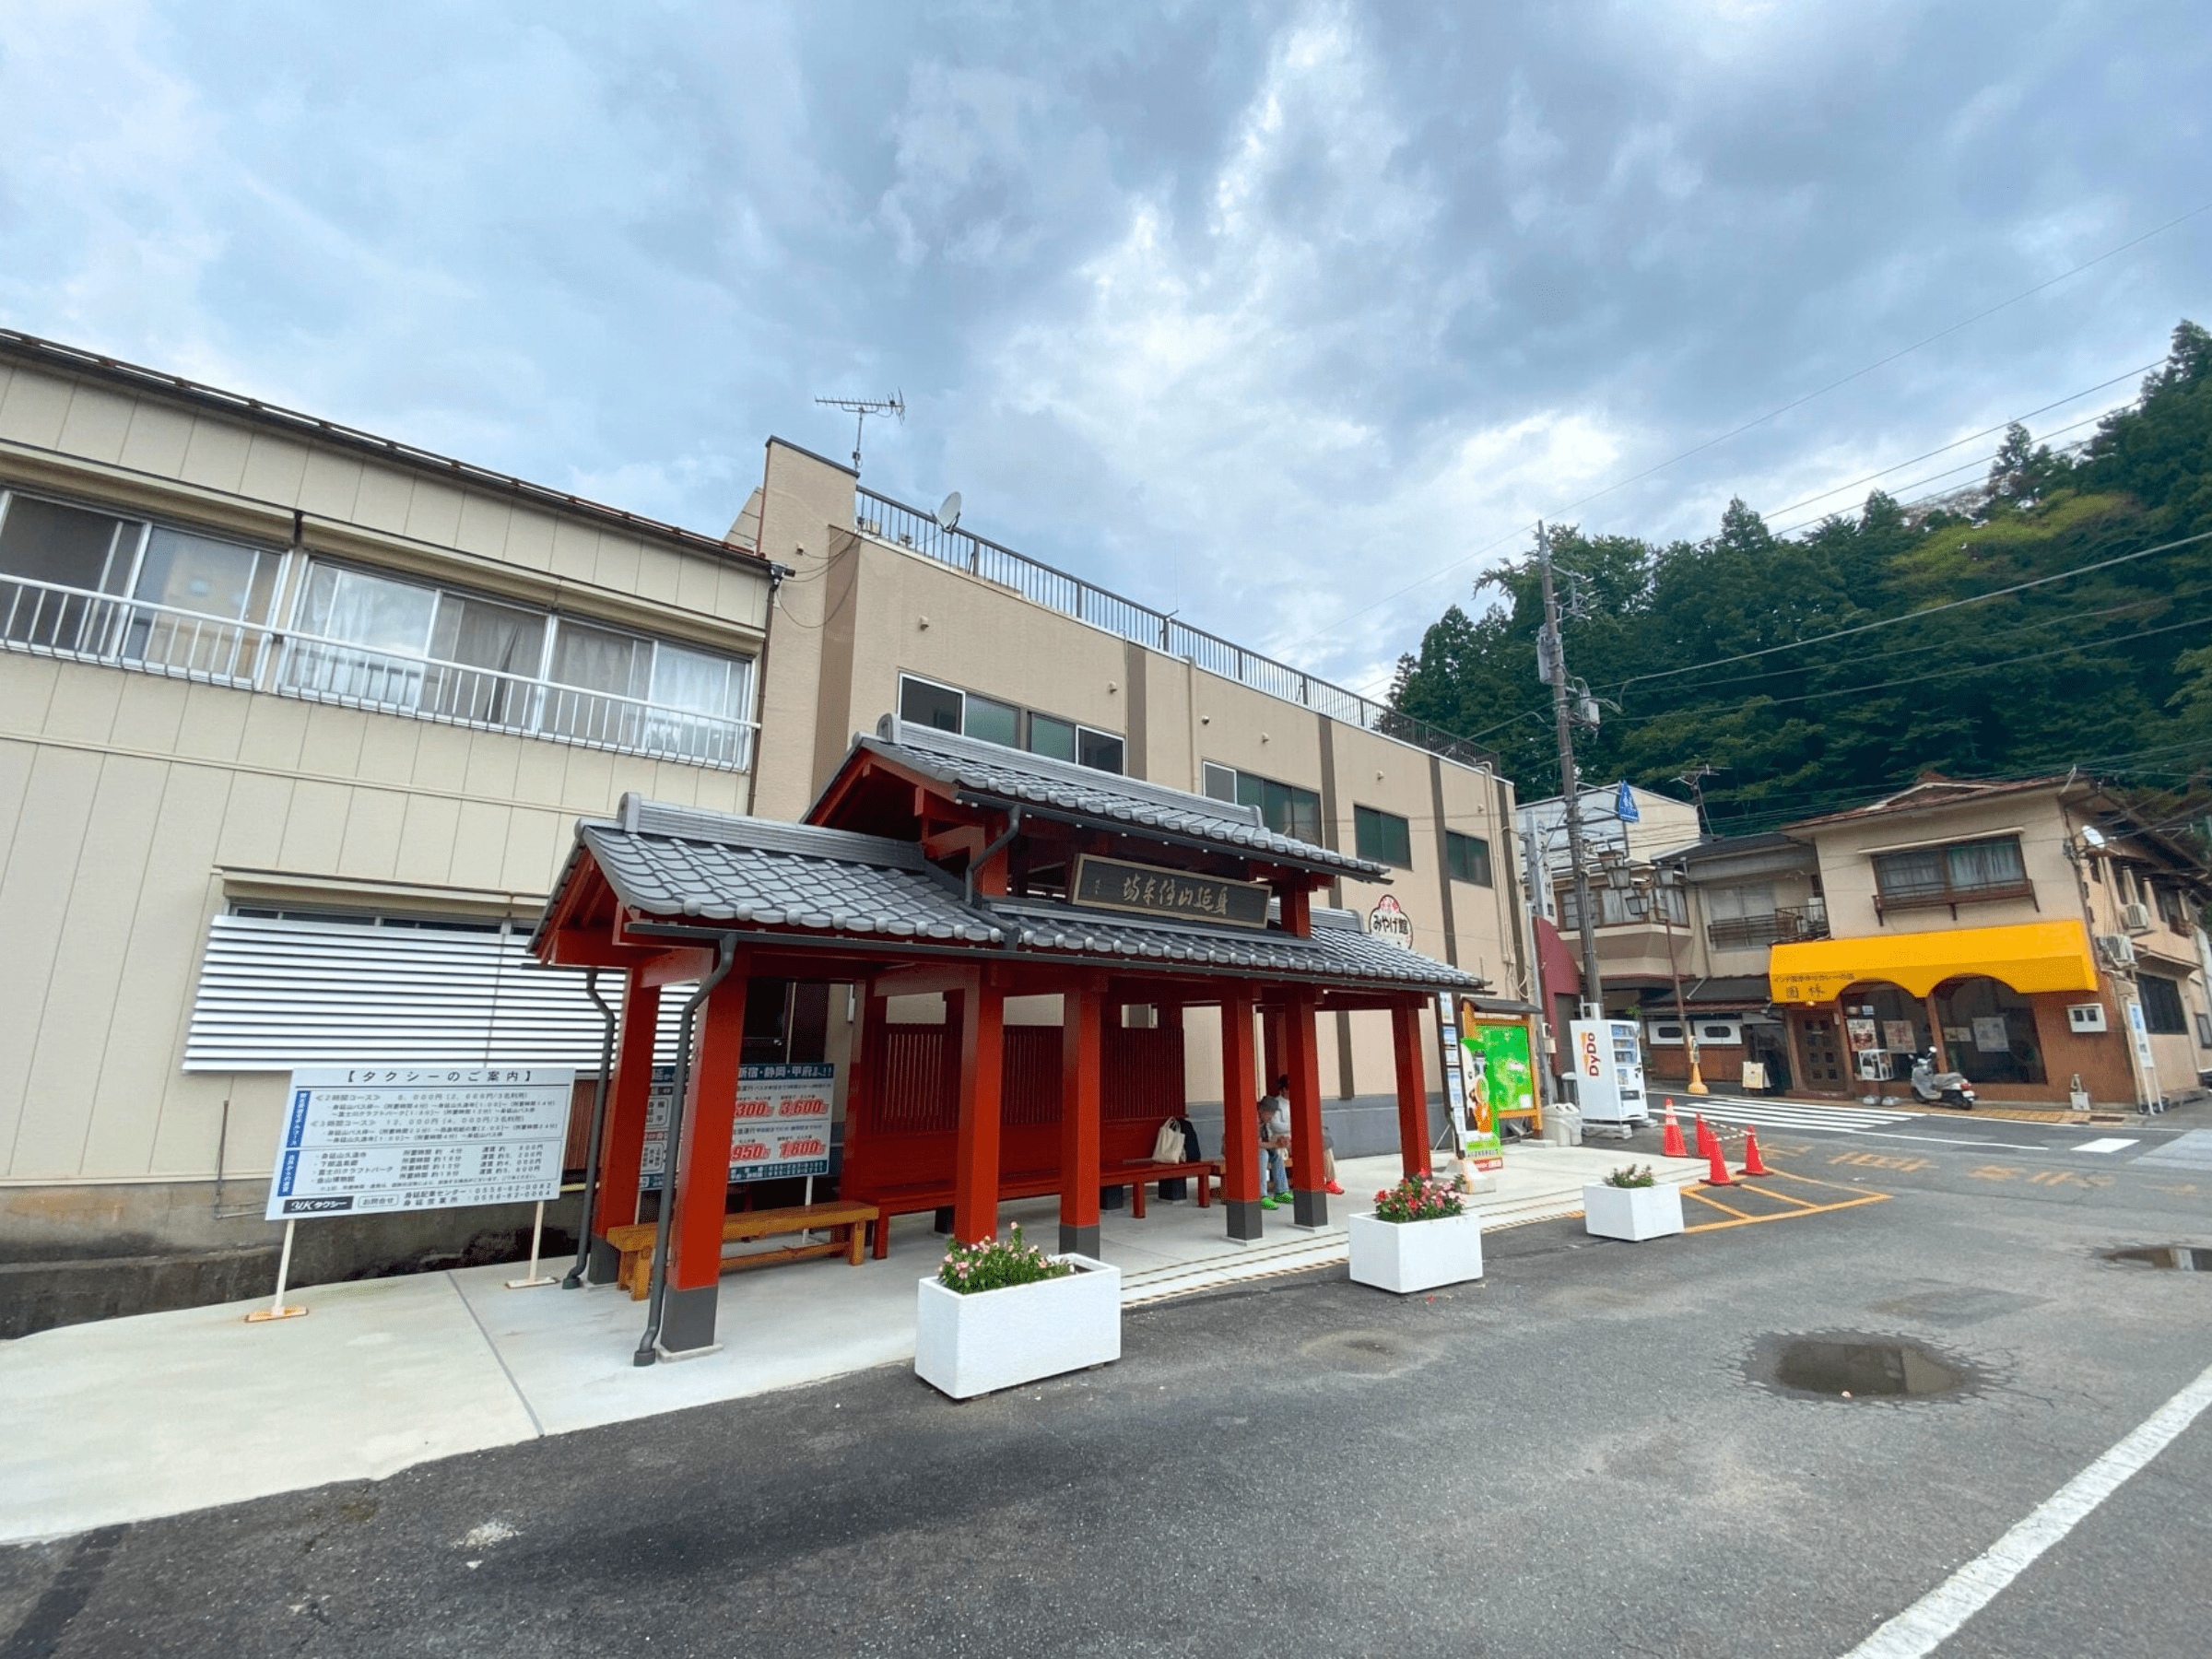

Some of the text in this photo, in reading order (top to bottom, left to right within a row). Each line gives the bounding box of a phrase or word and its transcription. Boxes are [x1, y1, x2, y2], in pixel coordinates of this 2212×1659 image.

[1372, 914, 1408, 935] みやげ館
[1586, 1031, 1601, 1077] DyDo
[347, 1070, 532, 1084] 【タクシーのご案内】
